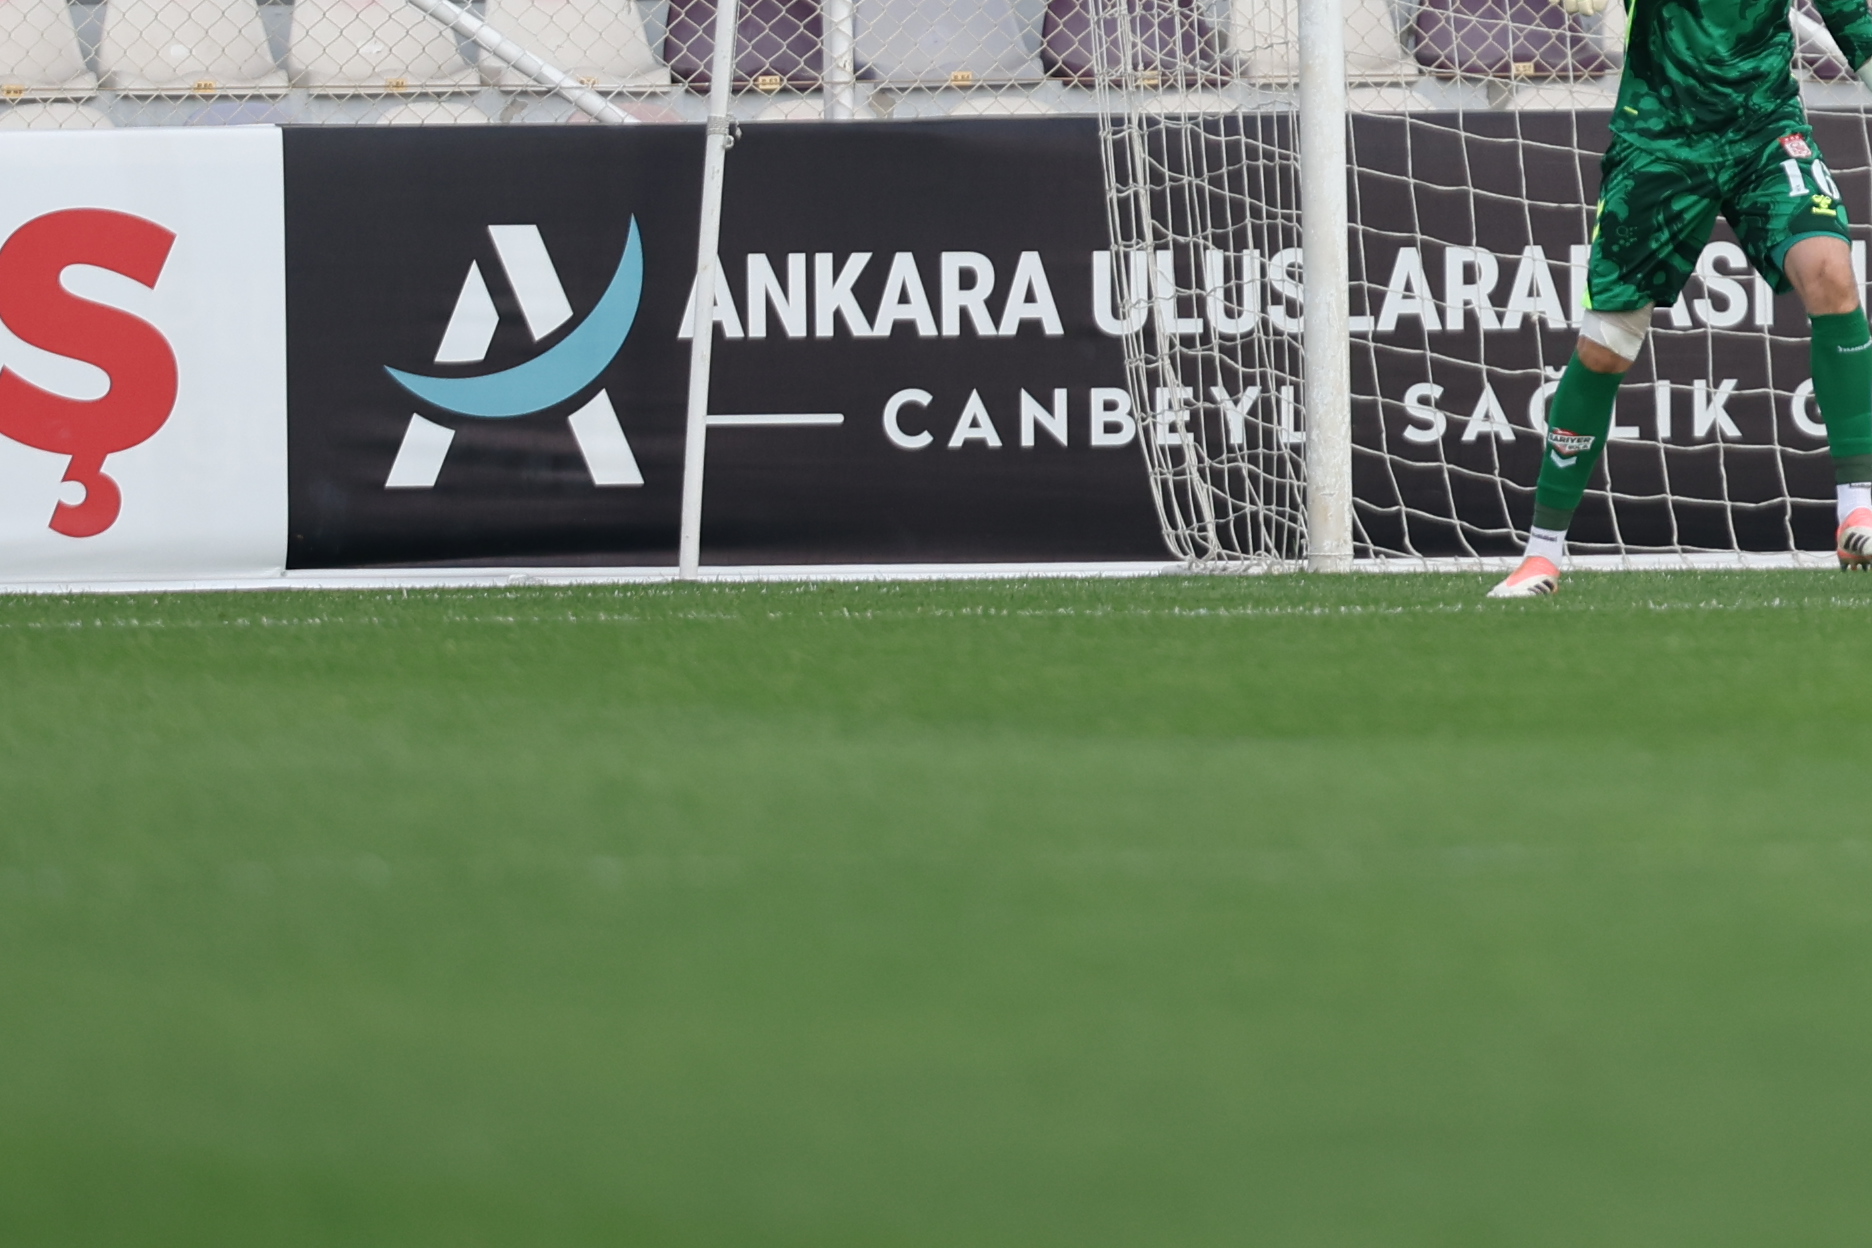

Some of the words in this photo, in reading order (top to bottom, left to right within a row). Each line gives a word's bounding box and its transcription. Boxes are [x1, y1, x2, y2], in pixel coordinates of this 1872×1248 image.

[1780, 158, 1841, 201] 16
[677, 251, 1064, 339] ANKARA
[1092, 241, 1774, 336] ULUSARASI
[0, 207, 179, 538] Ş
